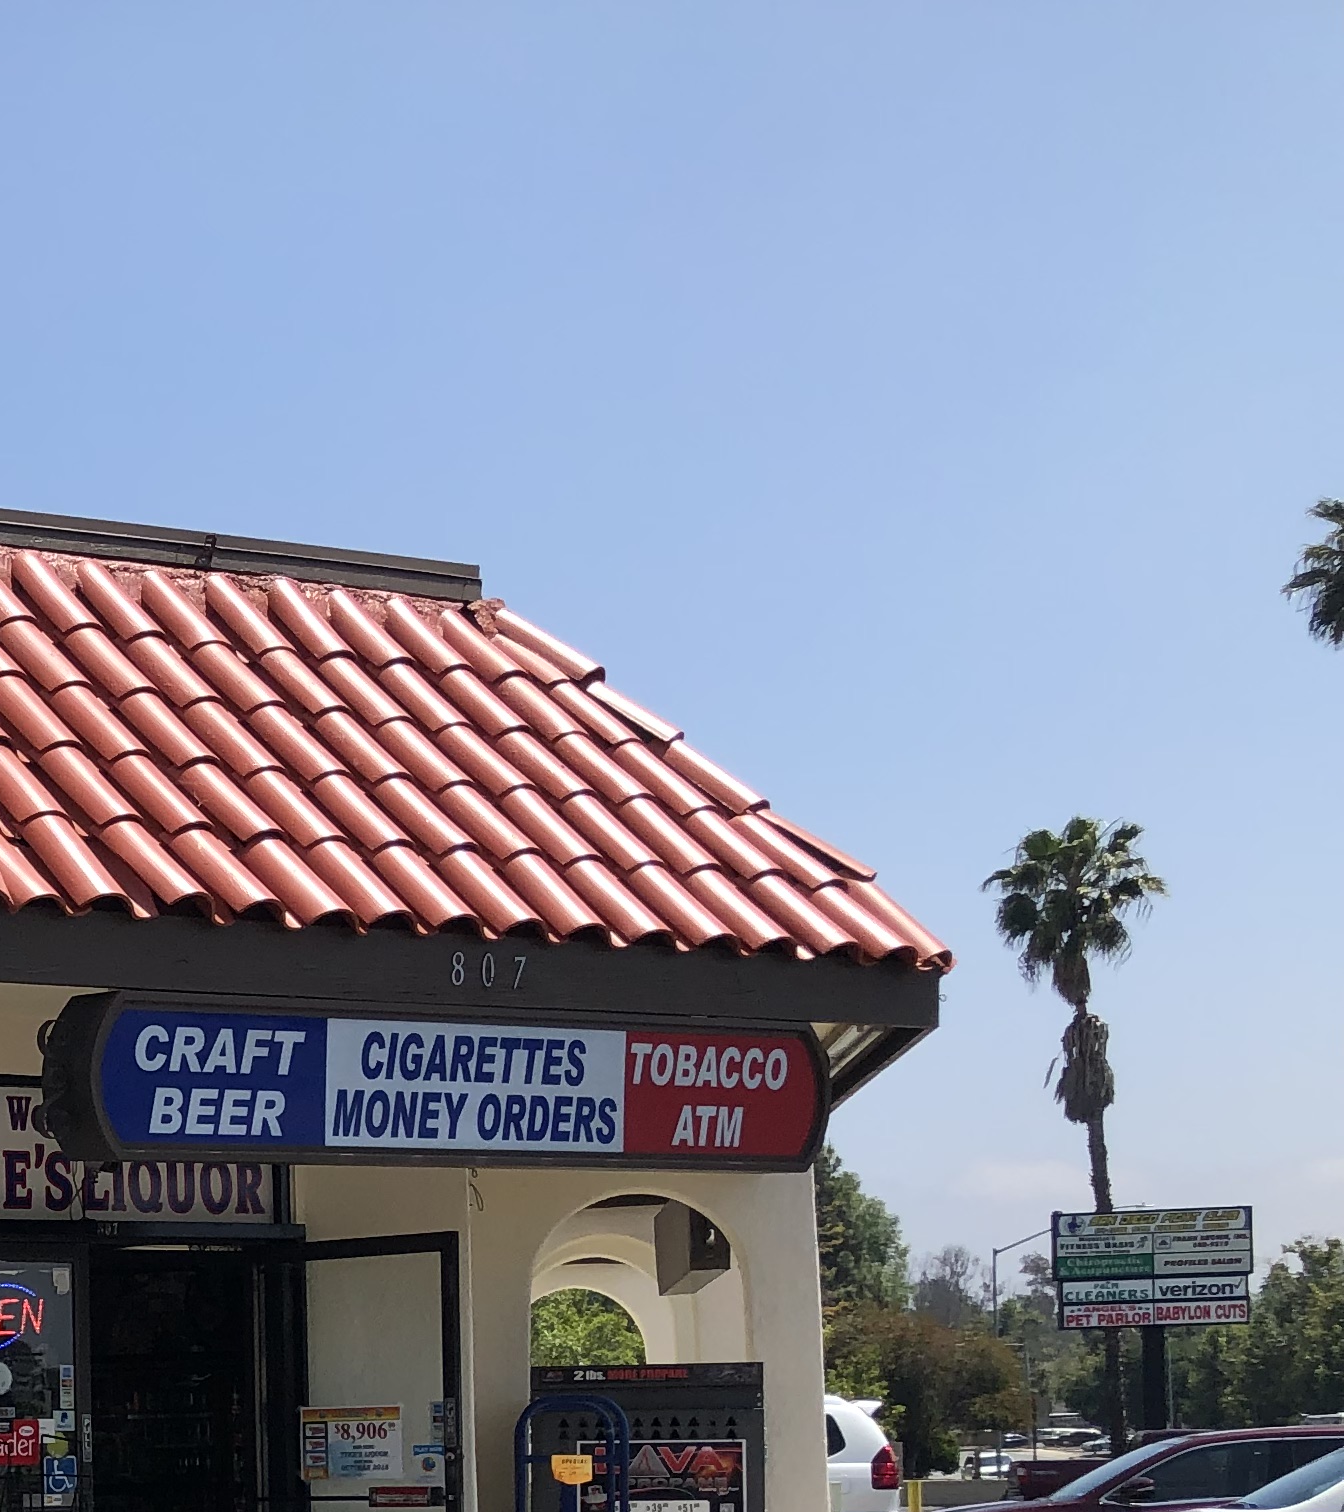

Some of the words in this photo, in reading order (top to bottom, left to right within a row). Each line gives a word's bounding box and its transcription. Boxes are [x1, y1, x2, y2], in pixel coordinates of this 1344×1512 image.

[450, 952, 529, 988] 807
[134, 1025, 306, 1076] CRAFT
[360, 1031, 586, 1086] CIGARETTES
[631, 1042, 789, 1092] TOBACCO
[148, 1090, 286, 1137] BEER
[332, 1092, 470, 1142] MONEY
[476, 1093, 618, 1146] ORDERS
[671, 1105, 744, 1149] ATM
[83, 1160, 266, 1215] LIQUOR
[1065, 1289, 1149, 1302] CLEANERS
[1159, 1280, 1234, 1298] verizon
[1066, 1314, 1092, 1327] PET
[1098, 1312, 1152, 1326] PARLOR
[1156, 1306, 1211, 1322] BABYLON
[1215, 1304, 1247, 1320] CUTS
[574, 1370, 584, 1380] 2
[585, 1370, 606, 1380] lbs.
